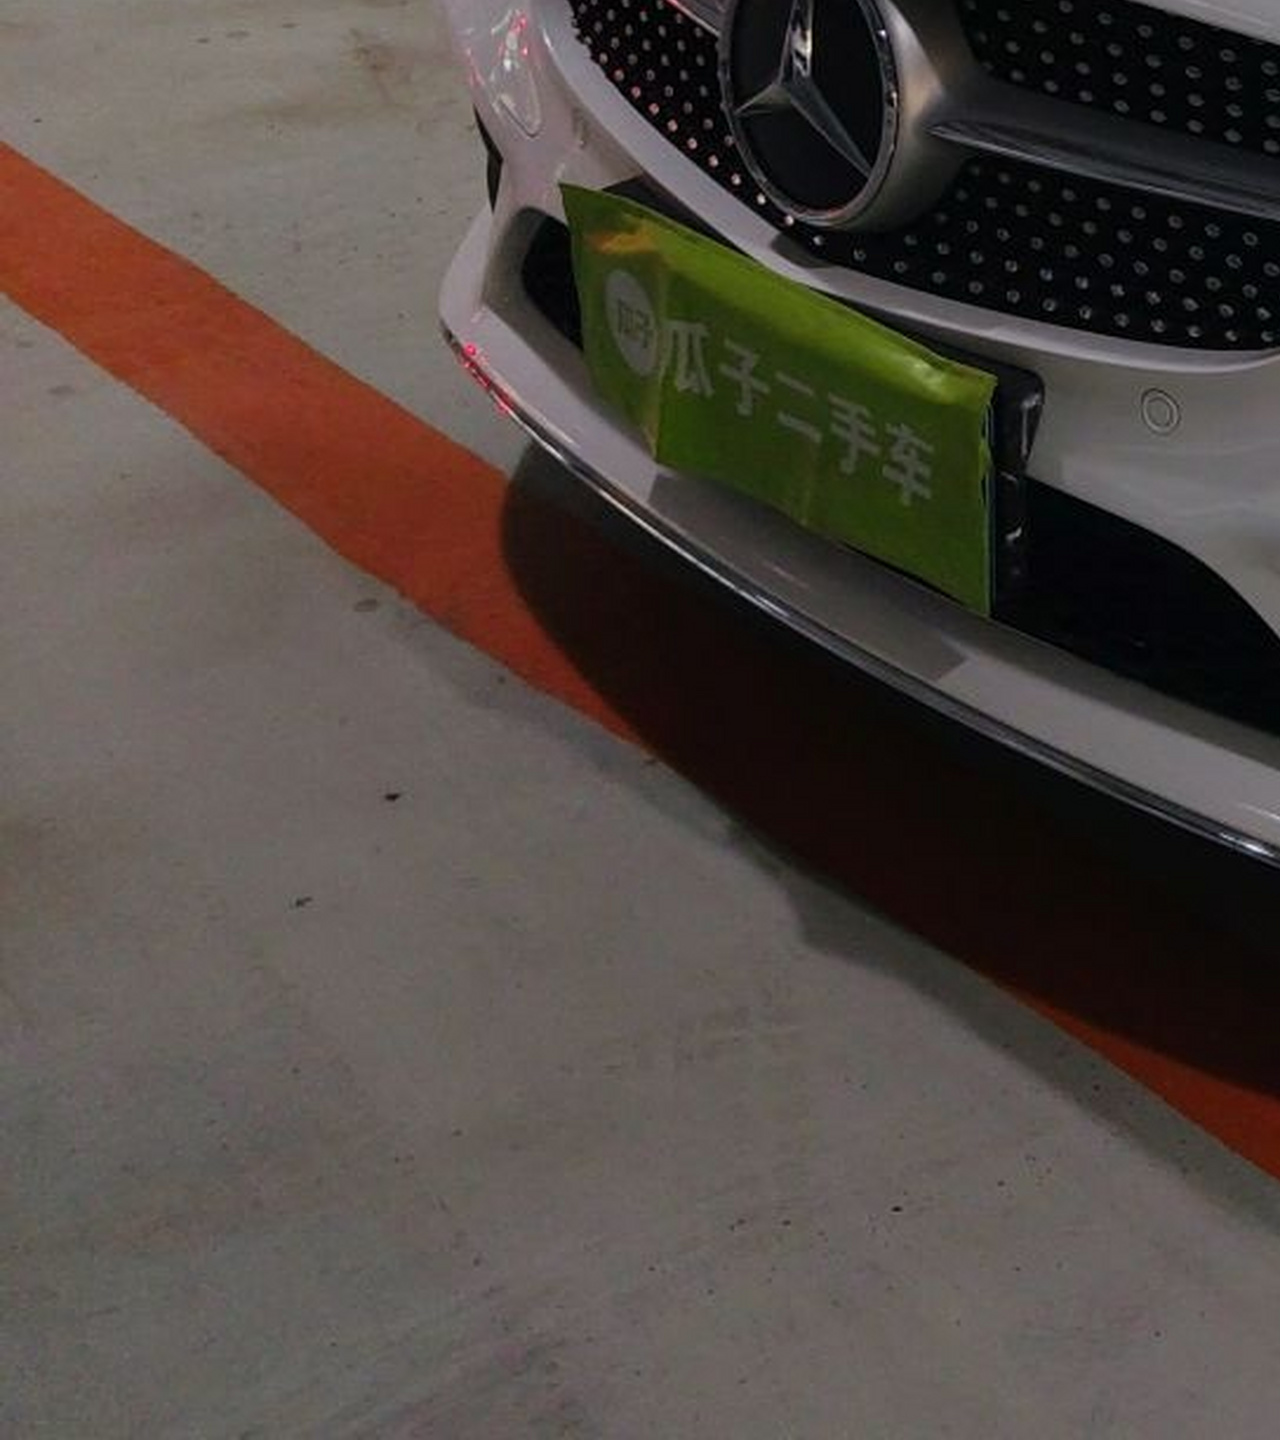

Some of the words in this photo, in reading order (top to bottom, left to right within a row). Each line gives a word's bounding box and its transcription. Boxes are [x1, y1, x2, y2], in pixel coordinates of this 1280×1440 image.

[656, 319, 934, 506] 瓜子二手车
